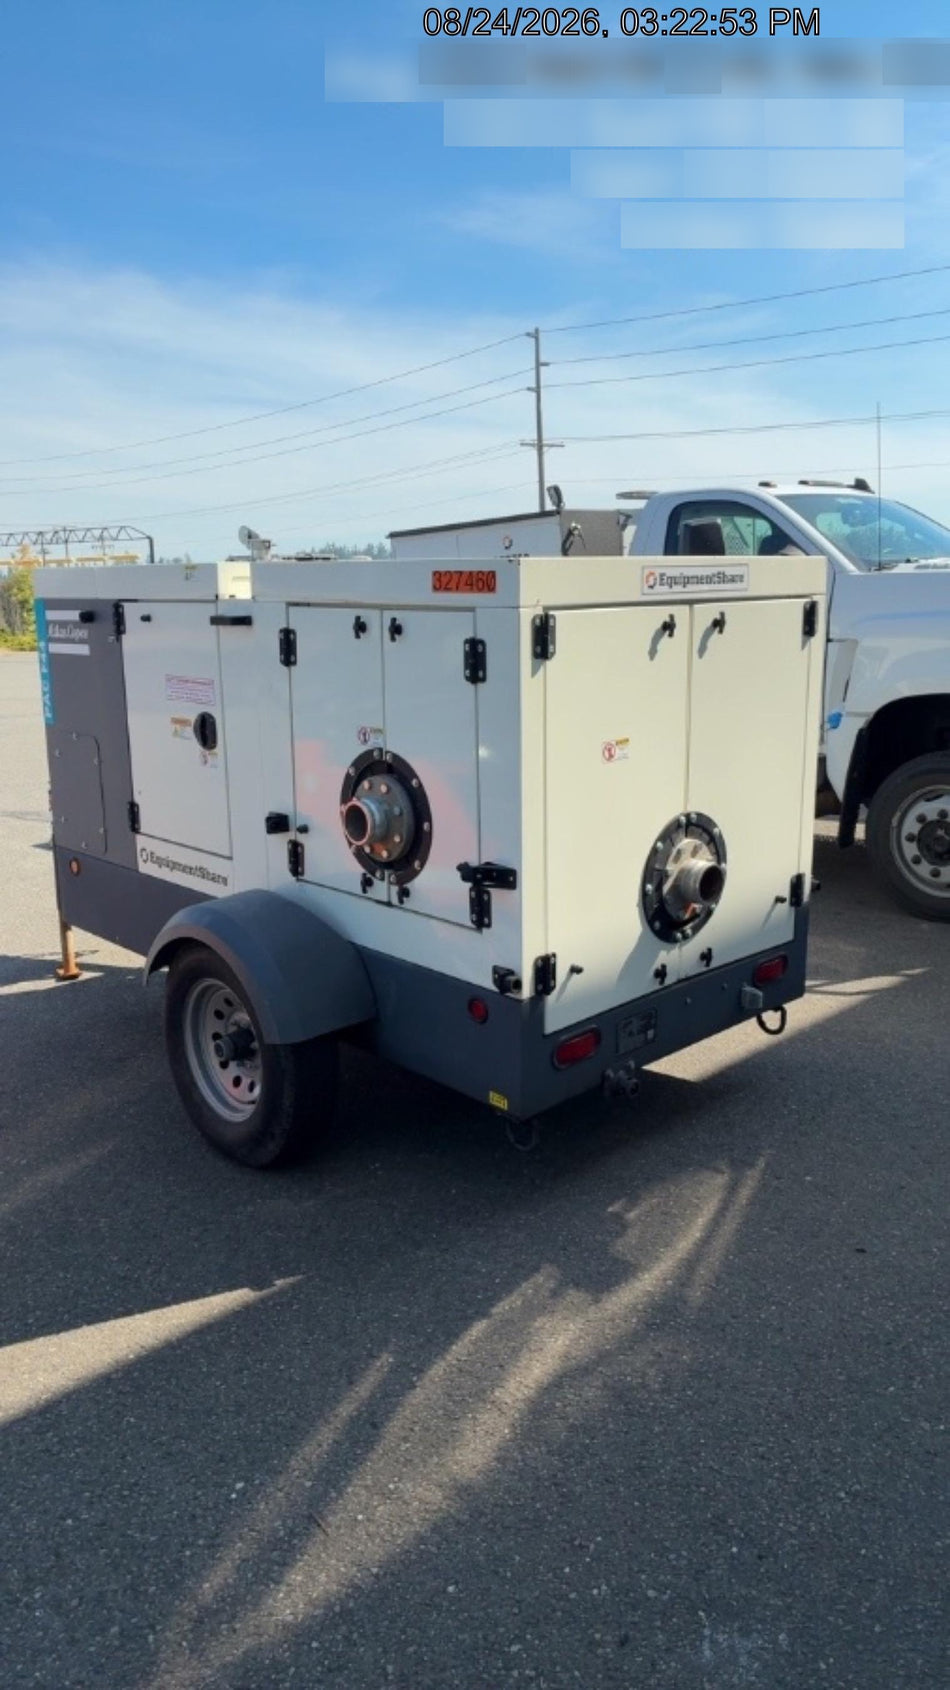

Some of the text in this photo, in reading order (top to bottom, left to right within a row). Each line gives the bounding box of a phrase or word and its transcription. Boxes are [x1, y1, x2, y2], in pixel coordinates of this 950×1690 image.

[433, 571, 496, 592] 327460
[658, 570, 745, 589] EquipmentShare
[150, 850, 229, 887] EquipmentShare
